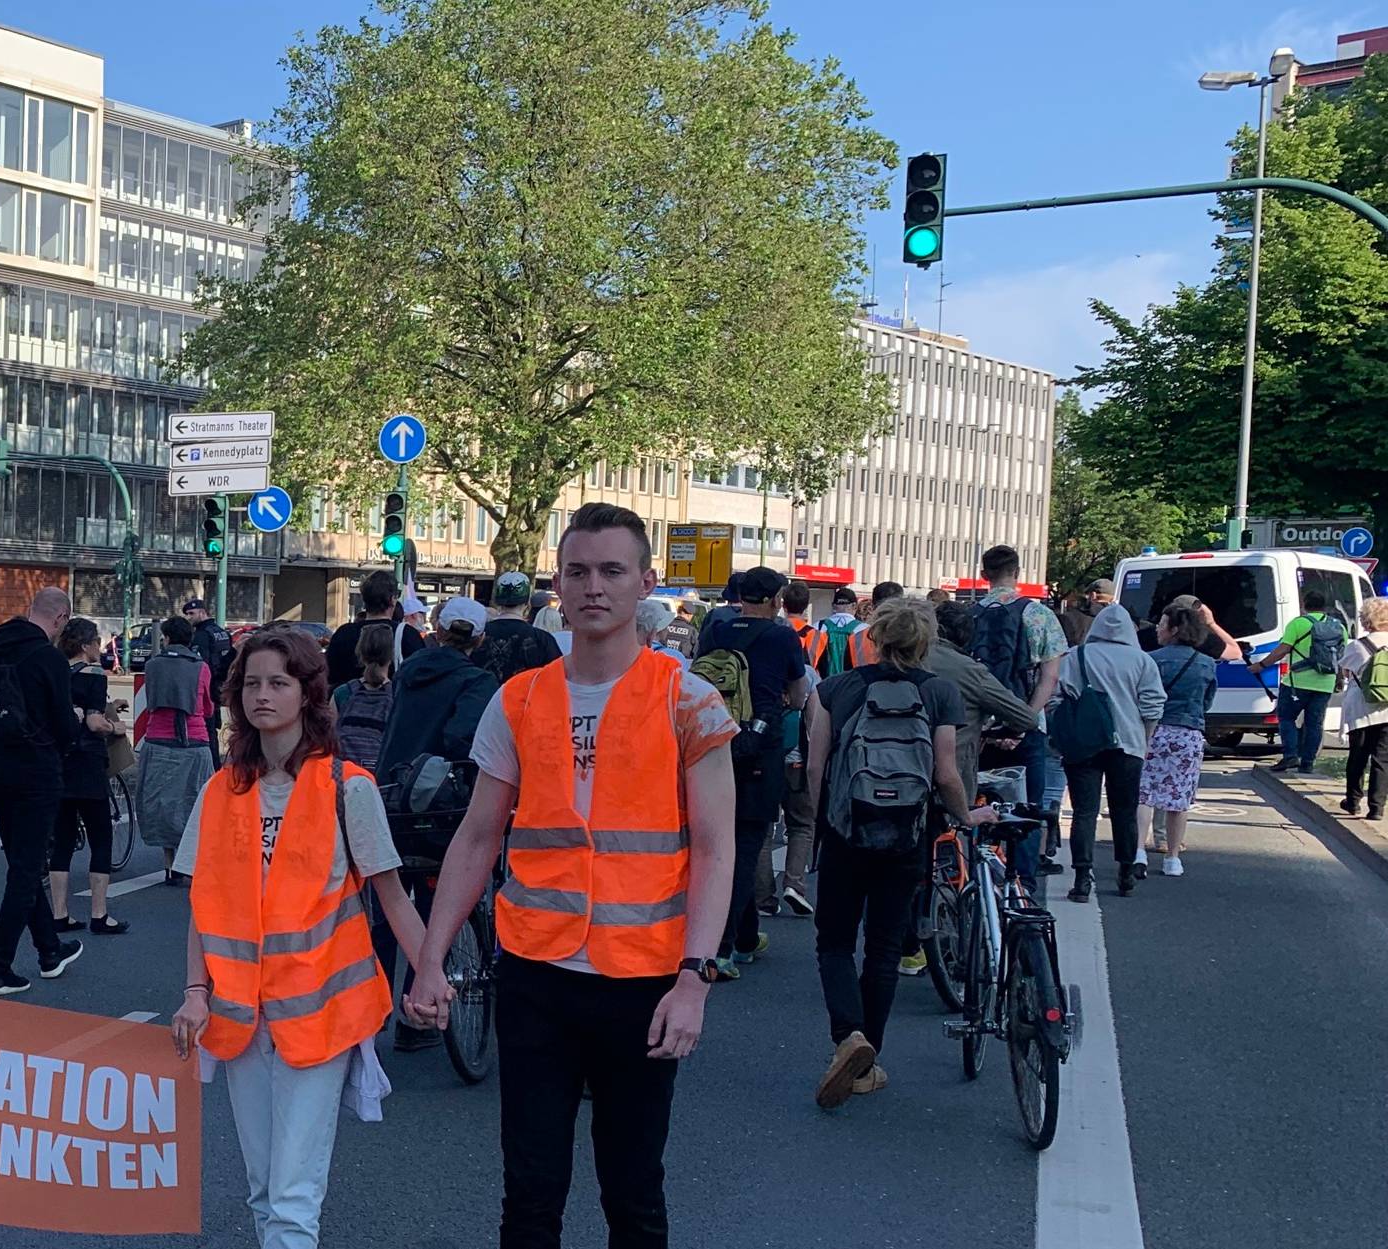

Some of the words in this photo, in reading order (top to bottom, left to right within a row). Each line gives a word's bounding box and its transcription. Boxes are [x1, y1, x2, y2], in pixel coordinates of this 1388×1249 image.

[190, 422, 234, 433] Stratmanns
[238, 420, 268, 431] Theater
[203, 445, 264, 459] Kennedyplatz
[208, 475, 230, 487] WDR
